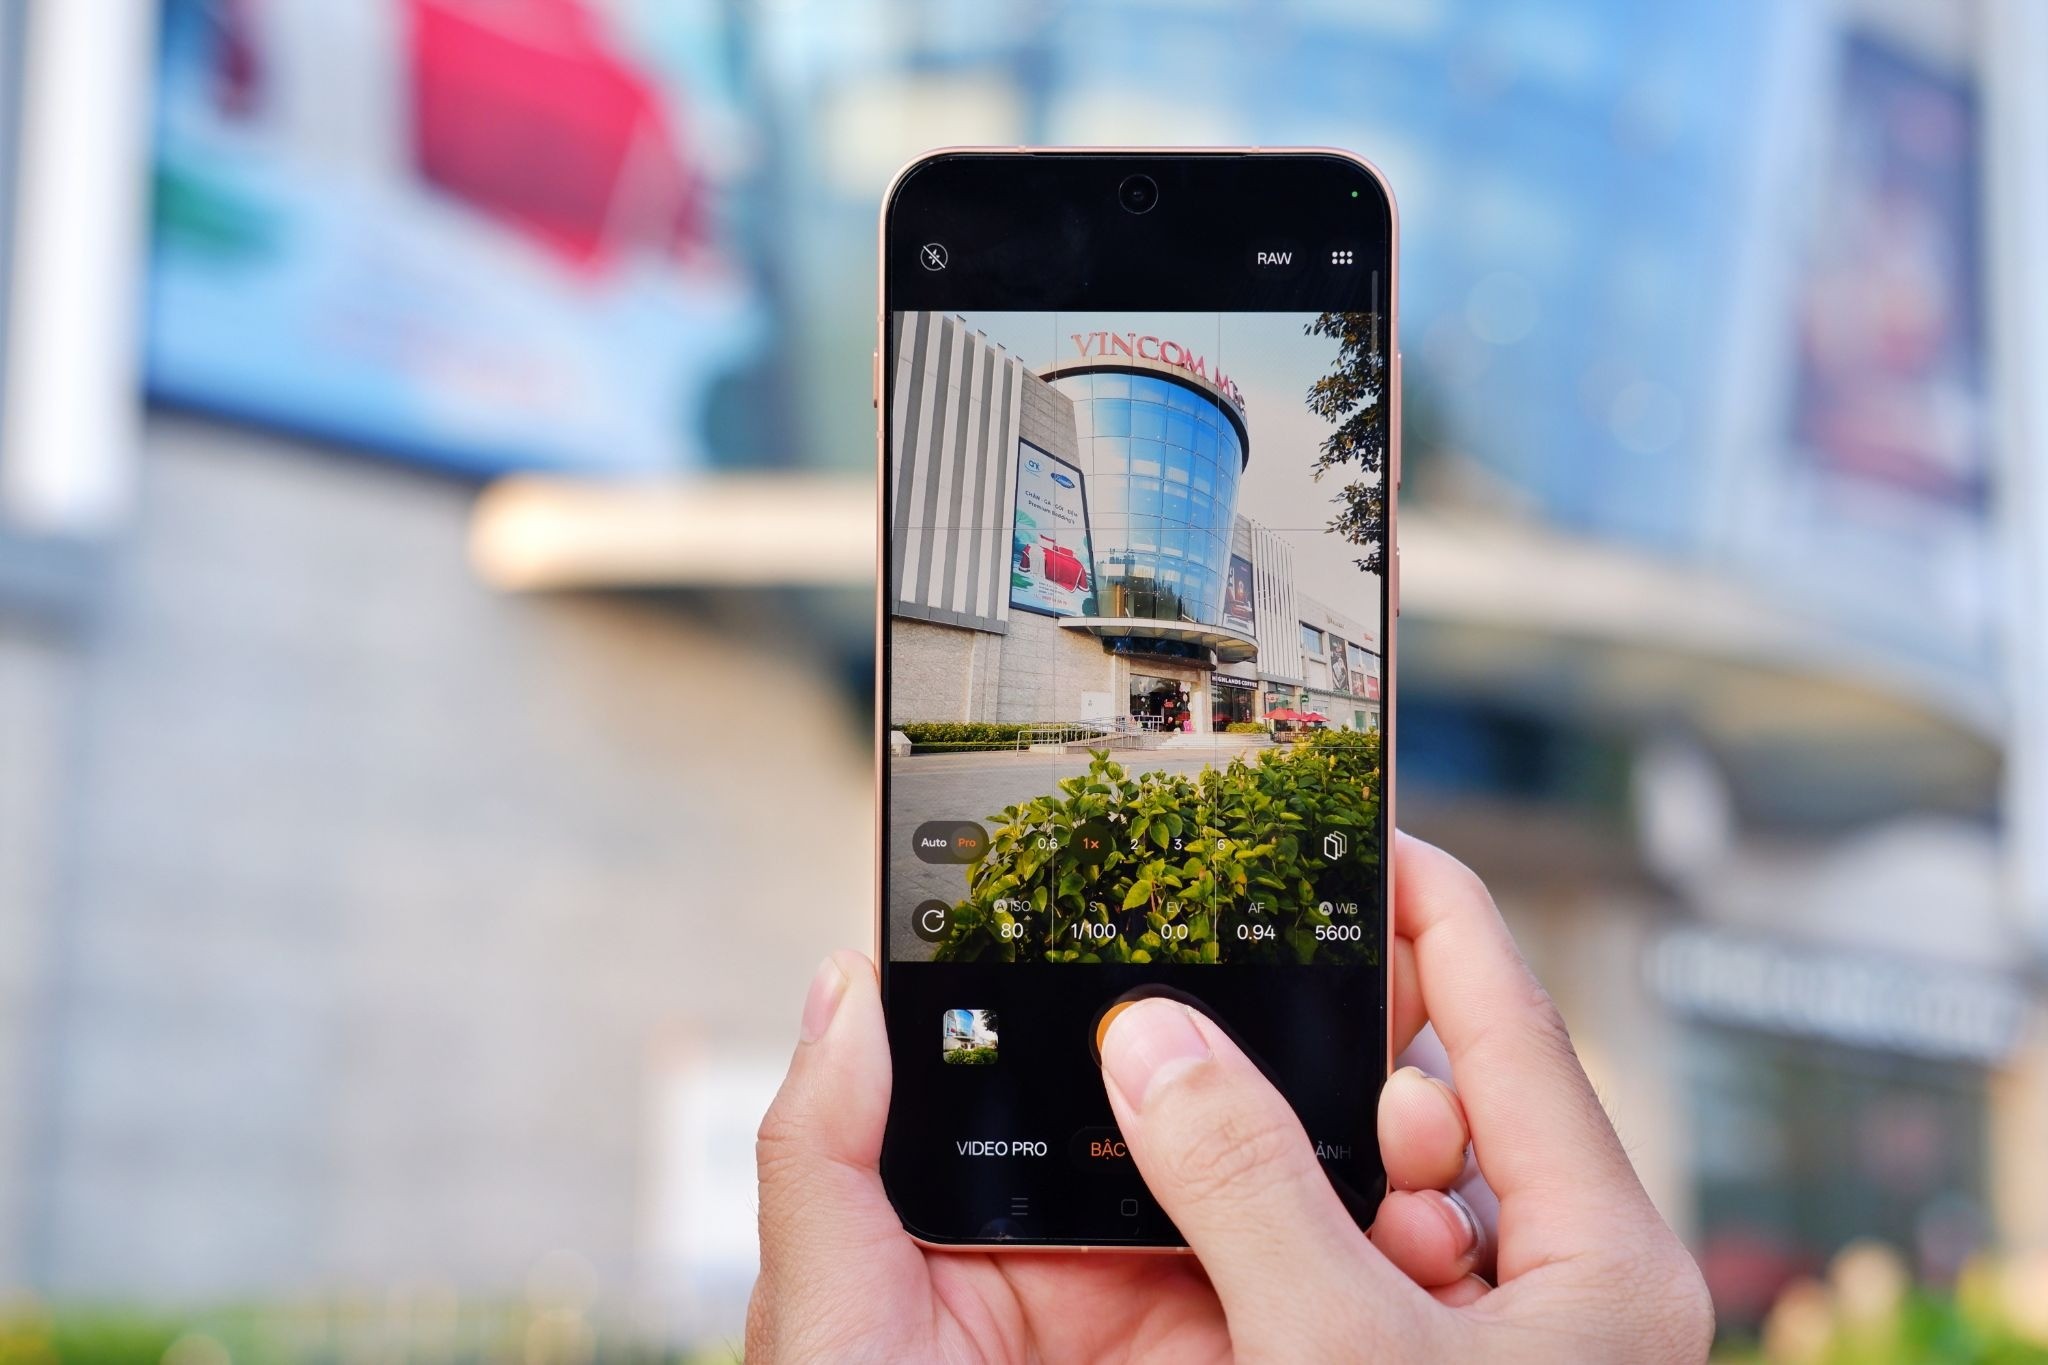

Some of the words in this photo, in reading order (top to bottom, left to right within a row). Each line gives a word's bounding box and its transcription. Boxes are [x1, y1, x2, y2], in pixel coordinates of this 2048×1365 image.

[1257, 252, 1292, 265] RAW
[1071, 332, 1208, 380] VINCOM
[1211, 675, 1241, 686] HIGHLANDS
[1241, 680, 1258, 688] COFFEE
[921, 837, 947, 848] Auto
[958, 837, 977, 848] Pro
[1130, 839, 1139, 850] 2
[1174, 839, 1183, 850] 3
[1217, 839, 1226, 850] 6
[1010, 901, 1031, 912] ISO
[1089, 901, 1098, 912] S
[1166, 902, 1183, 913] EV
[1248, 902, 1265, 914] AF
[1335, 903, 1358, 914] WB
[1001, 923, 1024, 938] 80
[1071, 923, 1116, 939] 1/100
[1161, 925, 1189, 940] 0.0
[1237, 925, 1276, 940] 0.94
[1315, 925, 1361, 941] 5600
[956, 1141, 1008, 1156] VIDEO
[1012, 1141, 1048, 1157] PRO
[1090, 1138, 1126, 1160] BẬC
